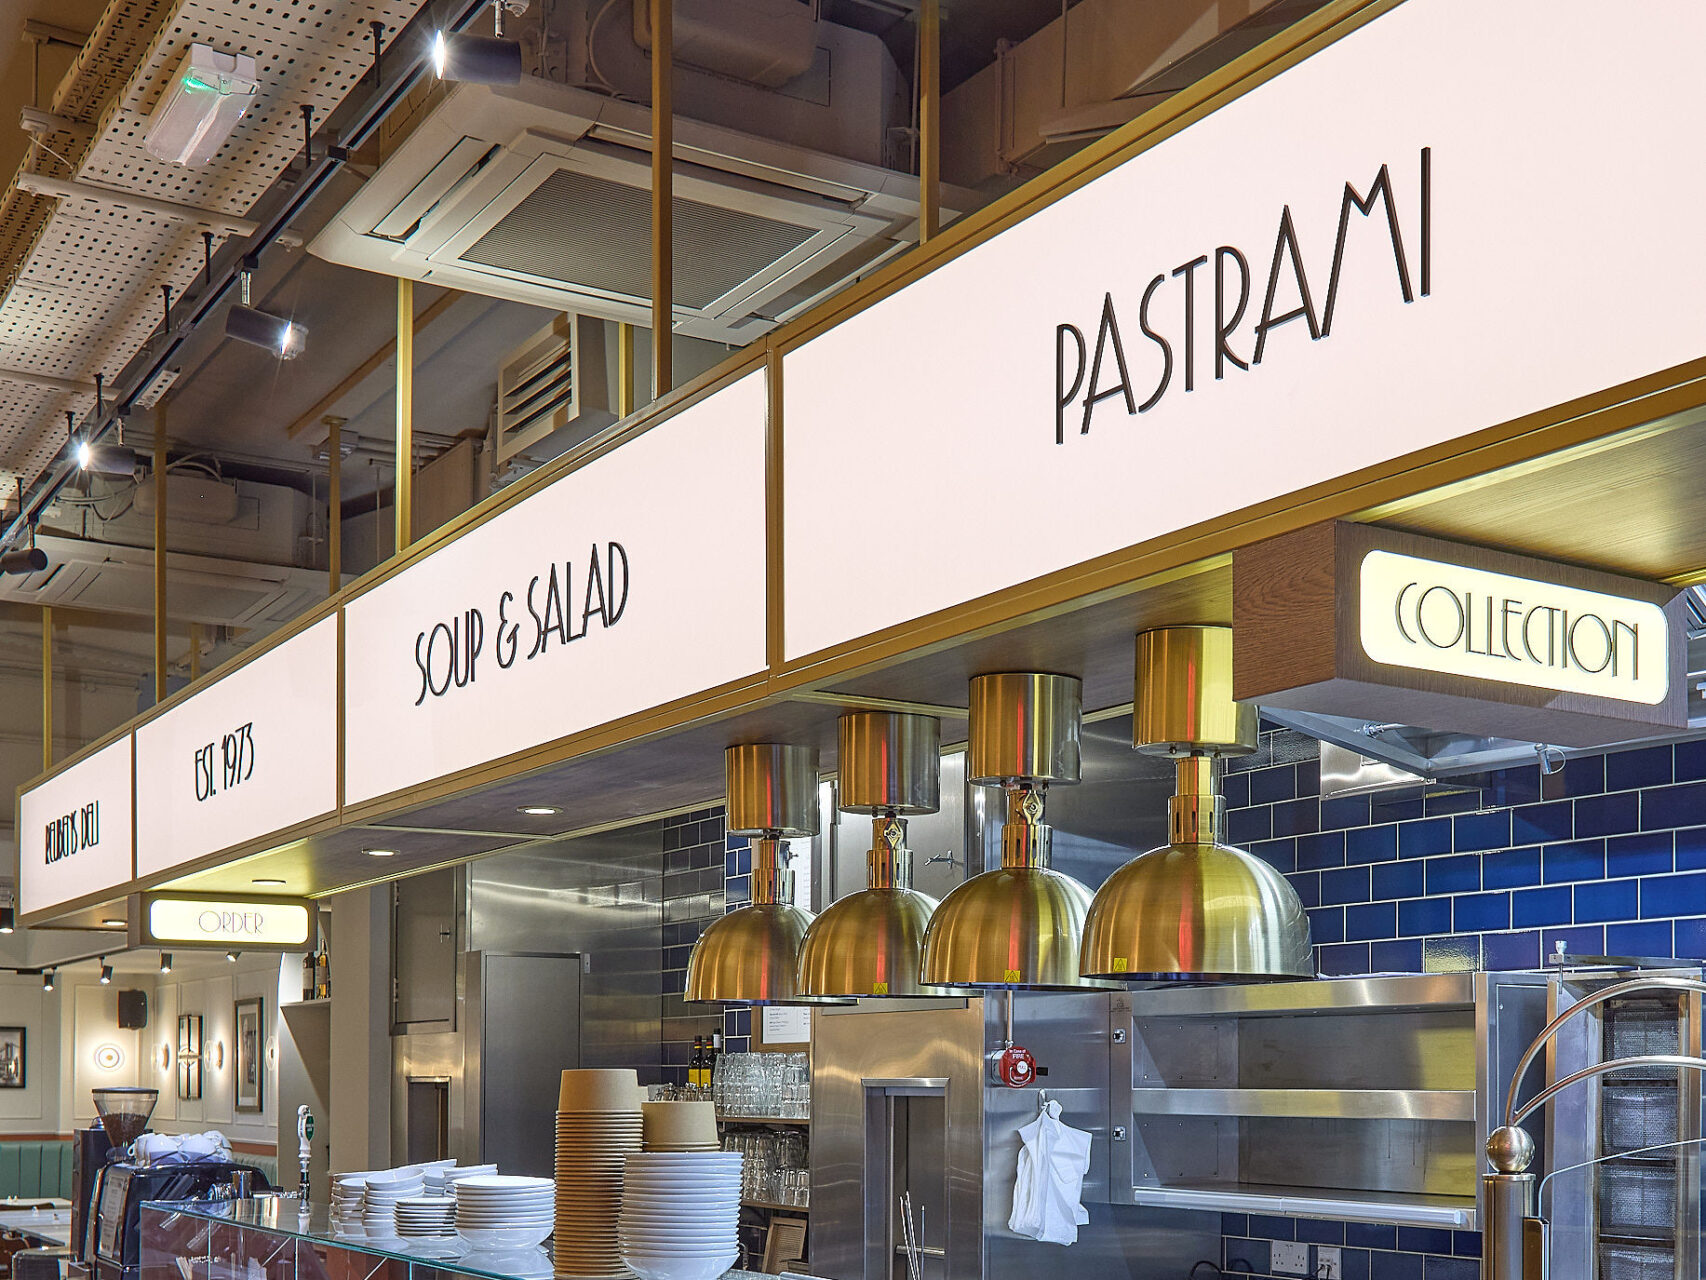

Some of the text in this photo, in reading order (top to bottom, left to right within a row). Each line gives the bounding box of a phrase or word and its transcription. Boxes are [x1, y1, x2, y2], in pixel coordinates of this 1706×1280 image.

[1056, 146, 1431, 445] PASTRAMI
[415, 542, 629, 706] SOUP & SALAD
[1395, 582, 1639, 680] COLLECTION
[194, 722, 254, 802] EST. 1973
[81, 800, 99, 850] DELI
[199, 910, 264, 935] ORDER
